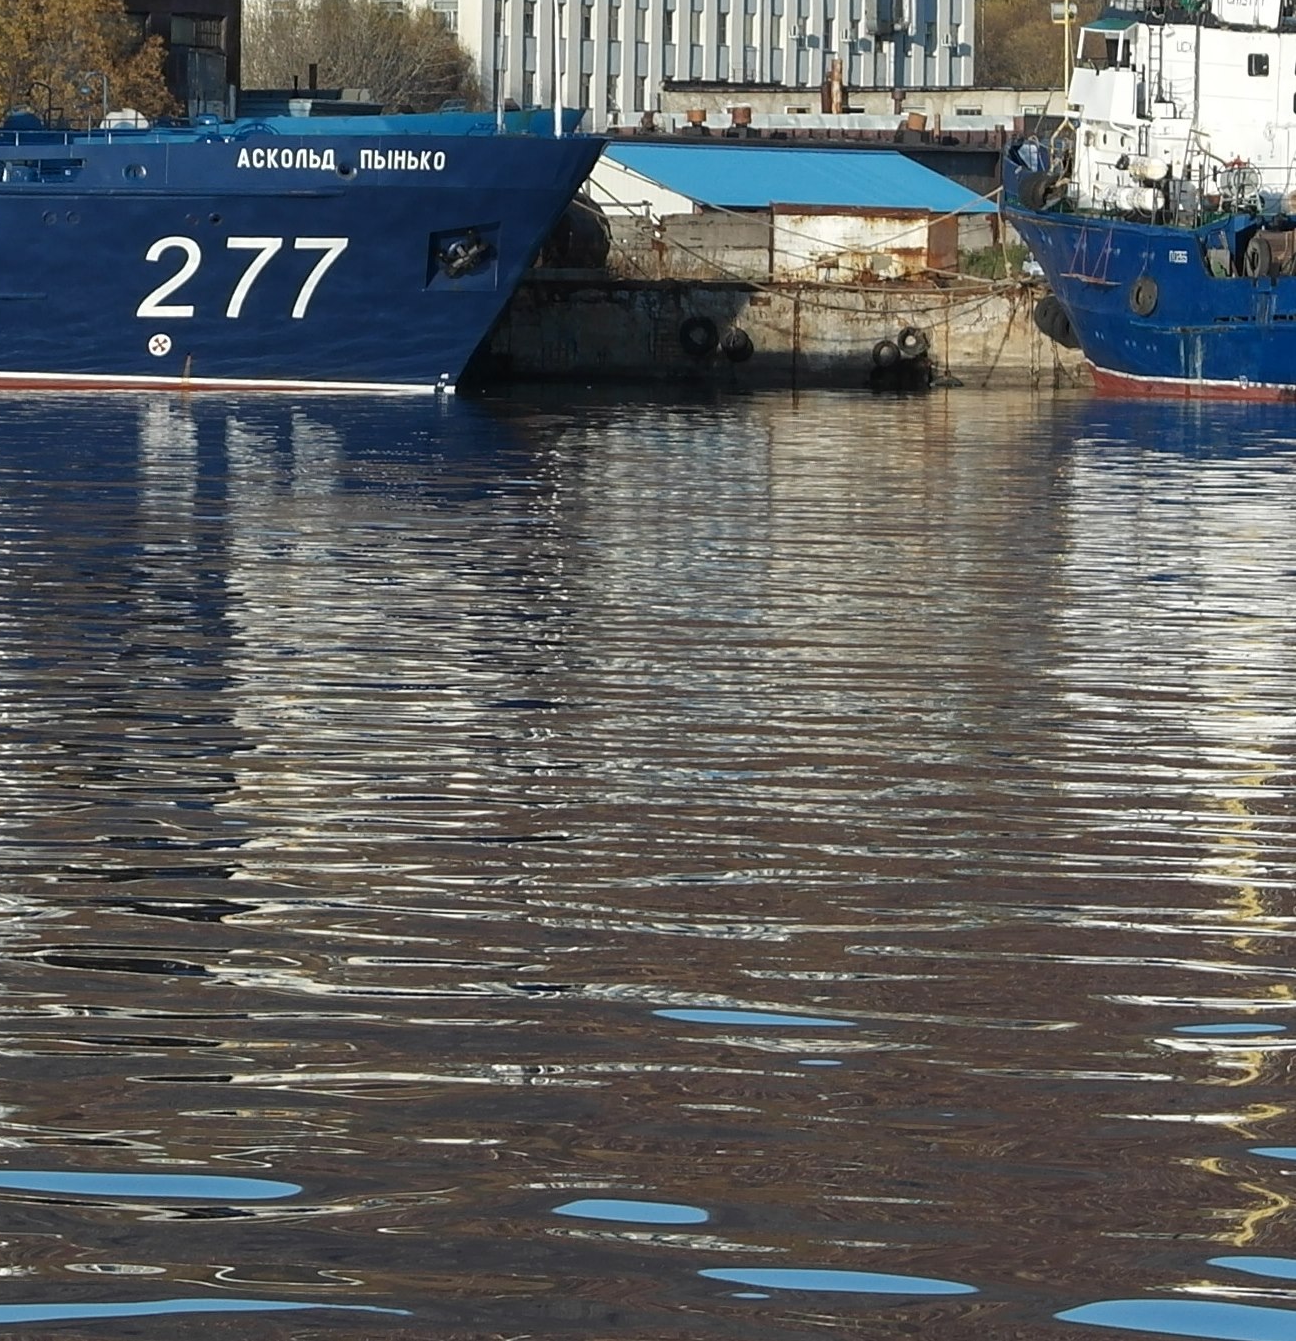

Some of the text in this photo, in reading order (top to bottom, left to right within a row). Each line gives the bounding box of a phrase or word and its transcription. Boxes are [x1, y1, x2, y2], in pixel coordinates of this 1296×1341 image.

[237, 148, 446, 171] АСКОЛЬД ПЫНЬКО
[136, 235, 349, 319] 277
